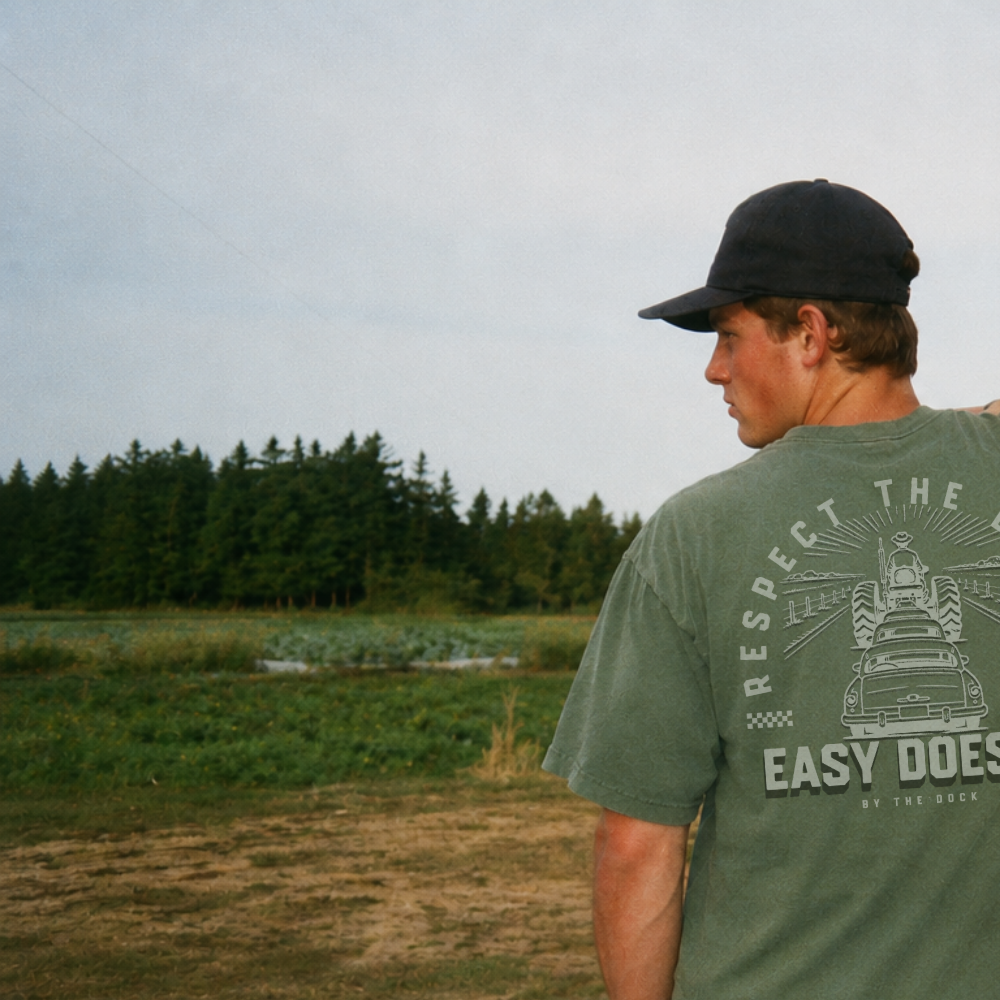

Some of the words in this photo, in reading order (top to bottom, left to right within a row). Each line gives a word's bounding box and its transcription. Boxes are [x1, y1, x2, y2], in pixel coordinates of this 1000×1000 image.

[739, 498, 840, 697] RESPECT
[874, 477, 963, 510] THE
[763, 741, 880, 798] EASY
[861, 798, 880, 809] BY
[893, 795, 923, 807] THE
[935, 791, 979, 804] DOCK
